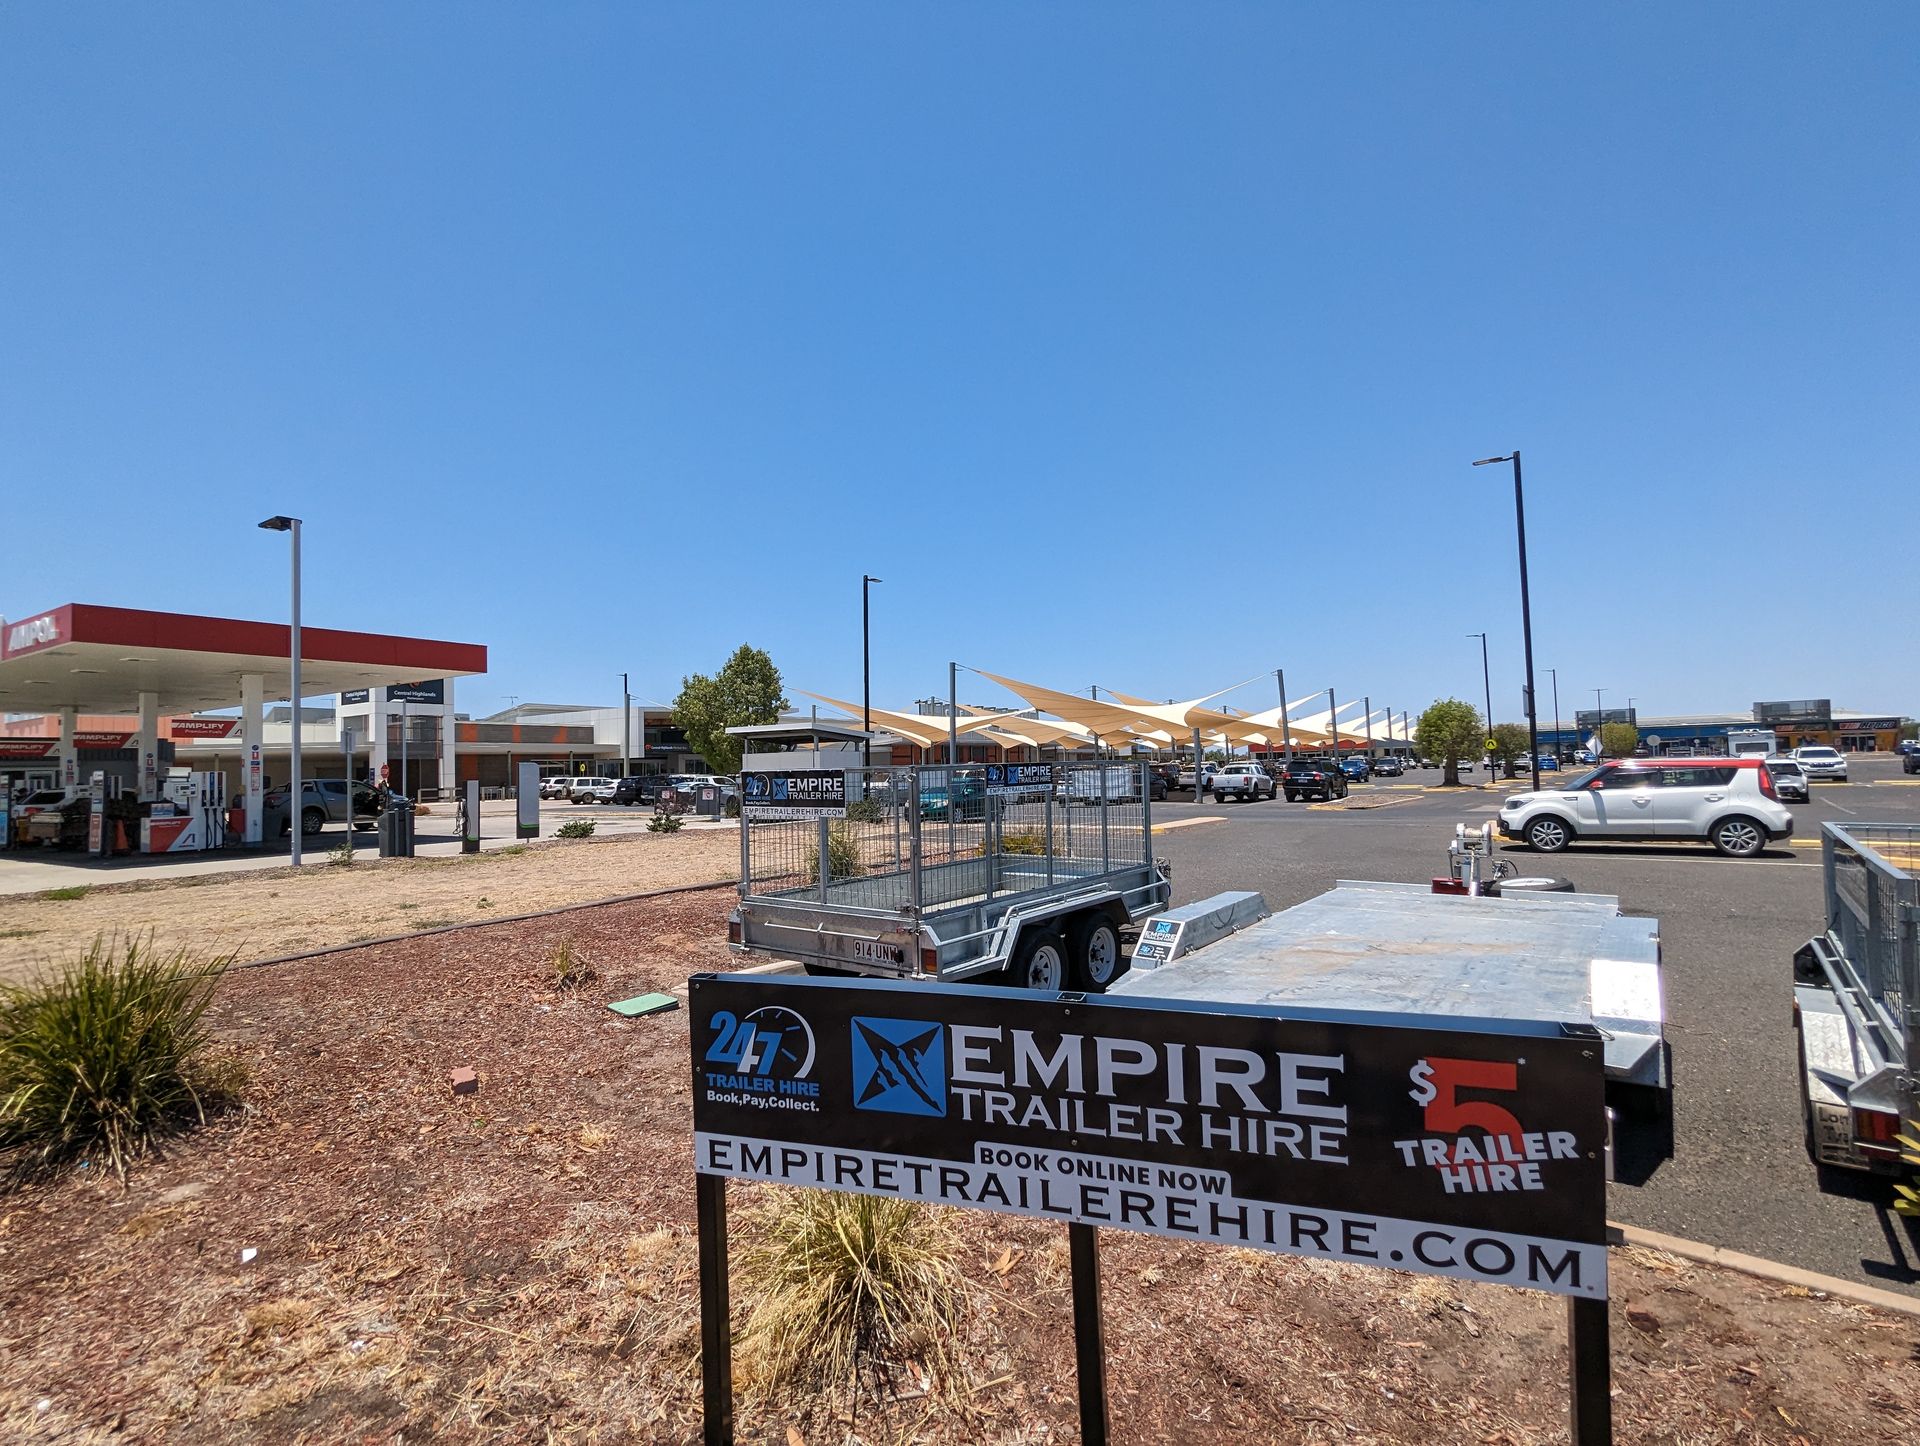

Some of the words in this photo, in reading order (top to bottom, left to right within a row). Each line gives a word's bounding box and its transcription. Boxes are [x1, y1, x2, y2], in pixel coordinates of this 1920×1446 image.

[788, 778, 843, 792] EMPIRE
[1018, 766, 1052, 777] EMPIRE
[788, 791, 821, 800] TRAILER
[823, 791, 844, 800] HIRE
[706, 1073, 775, 1092] TRAILER
[780, 1080, 820, 1097] HIRE
[949, 1024, 1348, 1124] EMPIRE
[951, 1086, 1183, 1146] TRAILER
[1200, 1112, 1349, 1166] HIRE
[1394, 1131, 1580, 1168] TRAILER
[980, 1147, 1049, 1173] BOOK
[1057, 1156, 1150, 1185] ONLINE
[1158, 1170, 1226, 1196] NOW
[1440, 1163, 1545, 1195] HIRE
[708, 1139, 1582, 1288] EMPIRETRAILEREHIRE.COM
